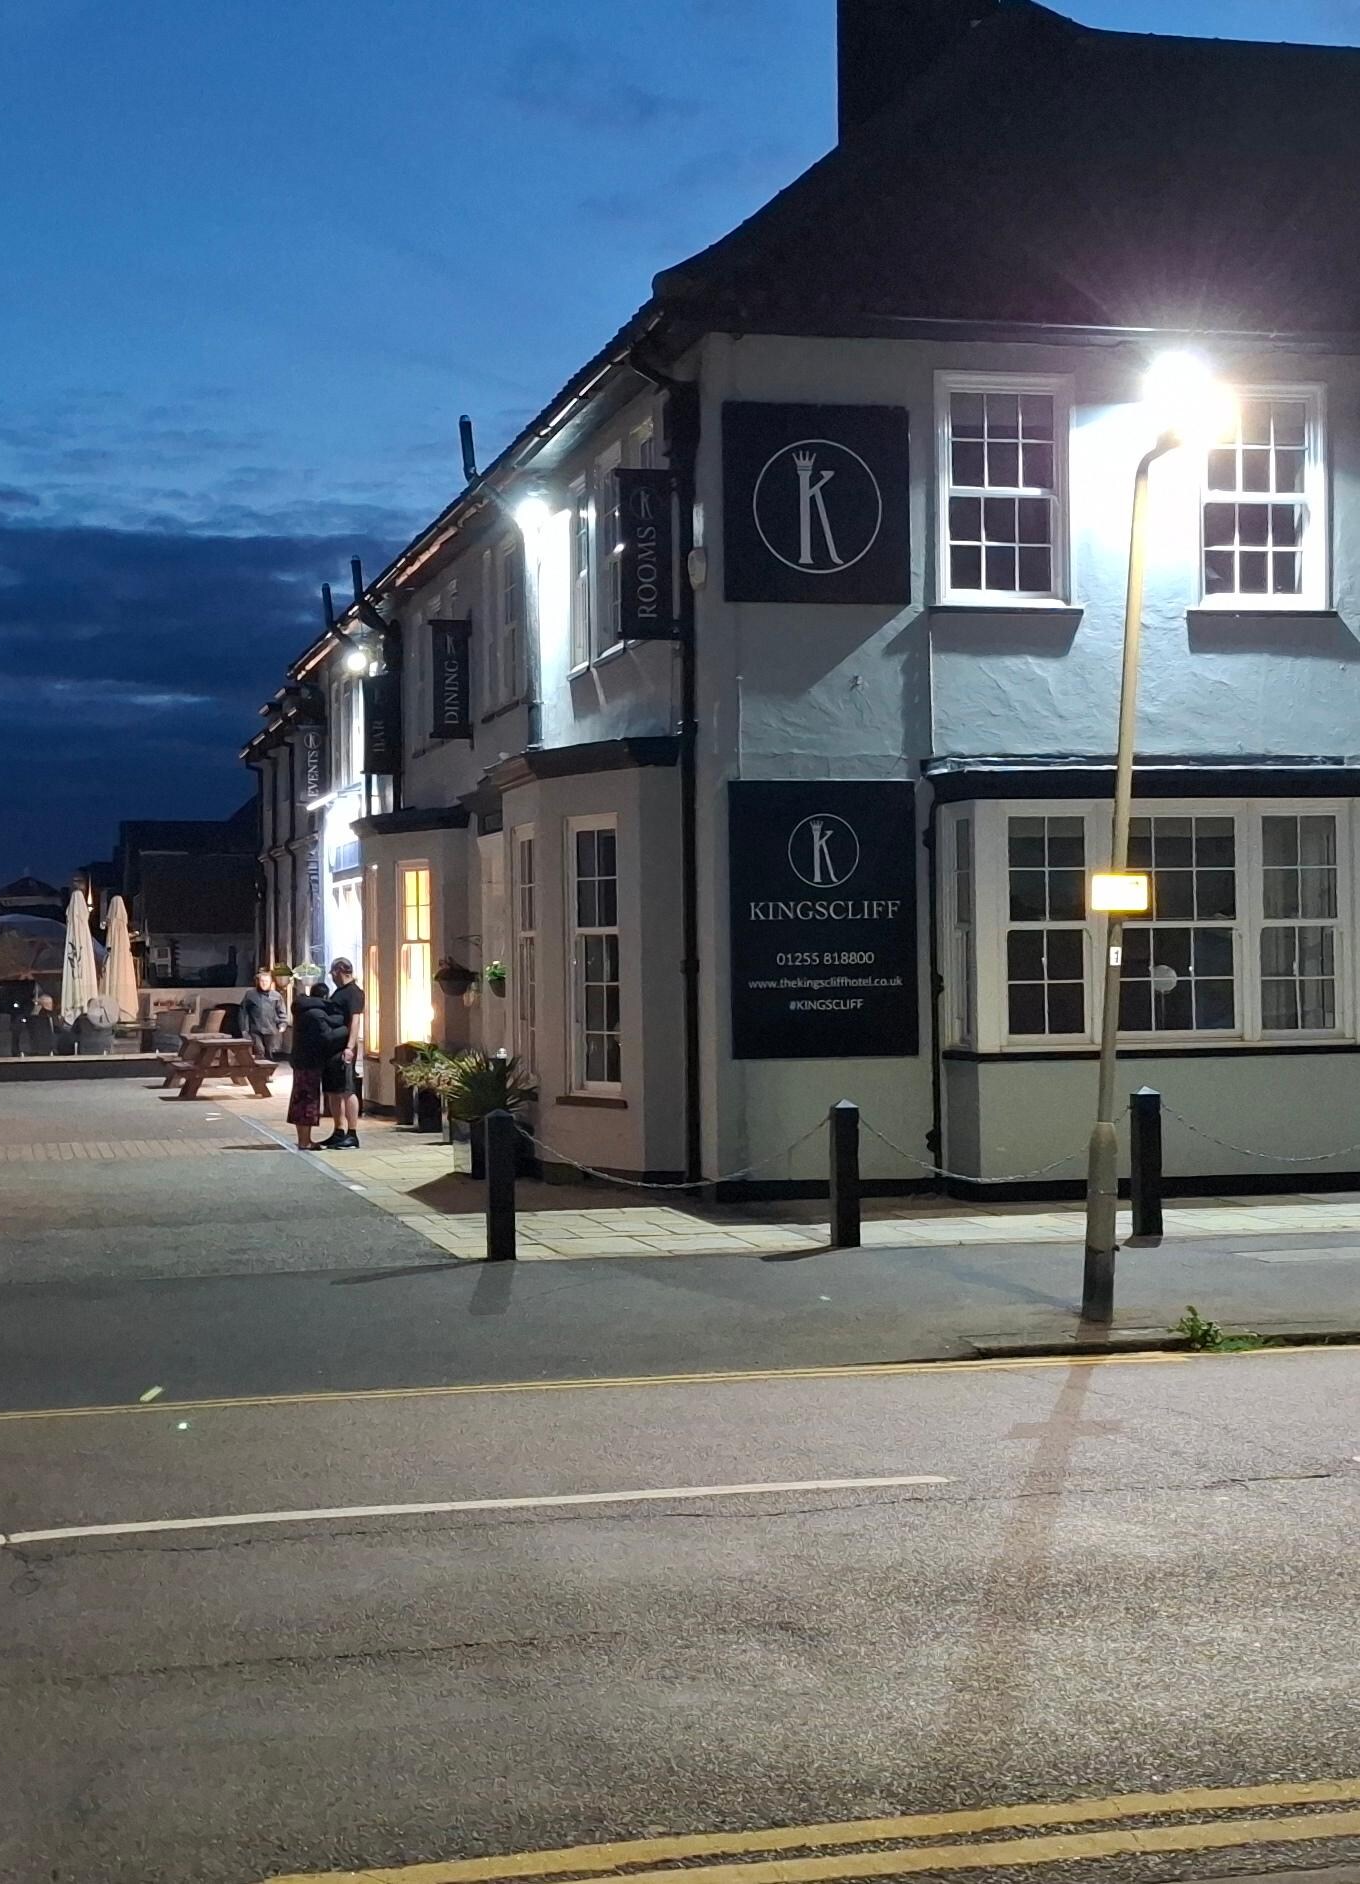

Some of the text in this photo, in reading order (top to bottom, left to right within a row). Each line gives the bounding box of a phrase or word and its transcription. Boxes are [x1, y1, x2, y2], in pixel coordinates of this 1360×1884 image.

[637, 527, 657, 618] ROOMS
[444, 660, 459, 724] DINING
[307, 751, 320, 798] EVENTS
[749, 900, 901, 921] KINGSCLIFF
[776, 951, 875, 966] 01255 818800
[748, 974, 903, 991] www.thekingscliffhotel.co.uk
[789, 998, 865, 1011] #KINGSCLIFF
